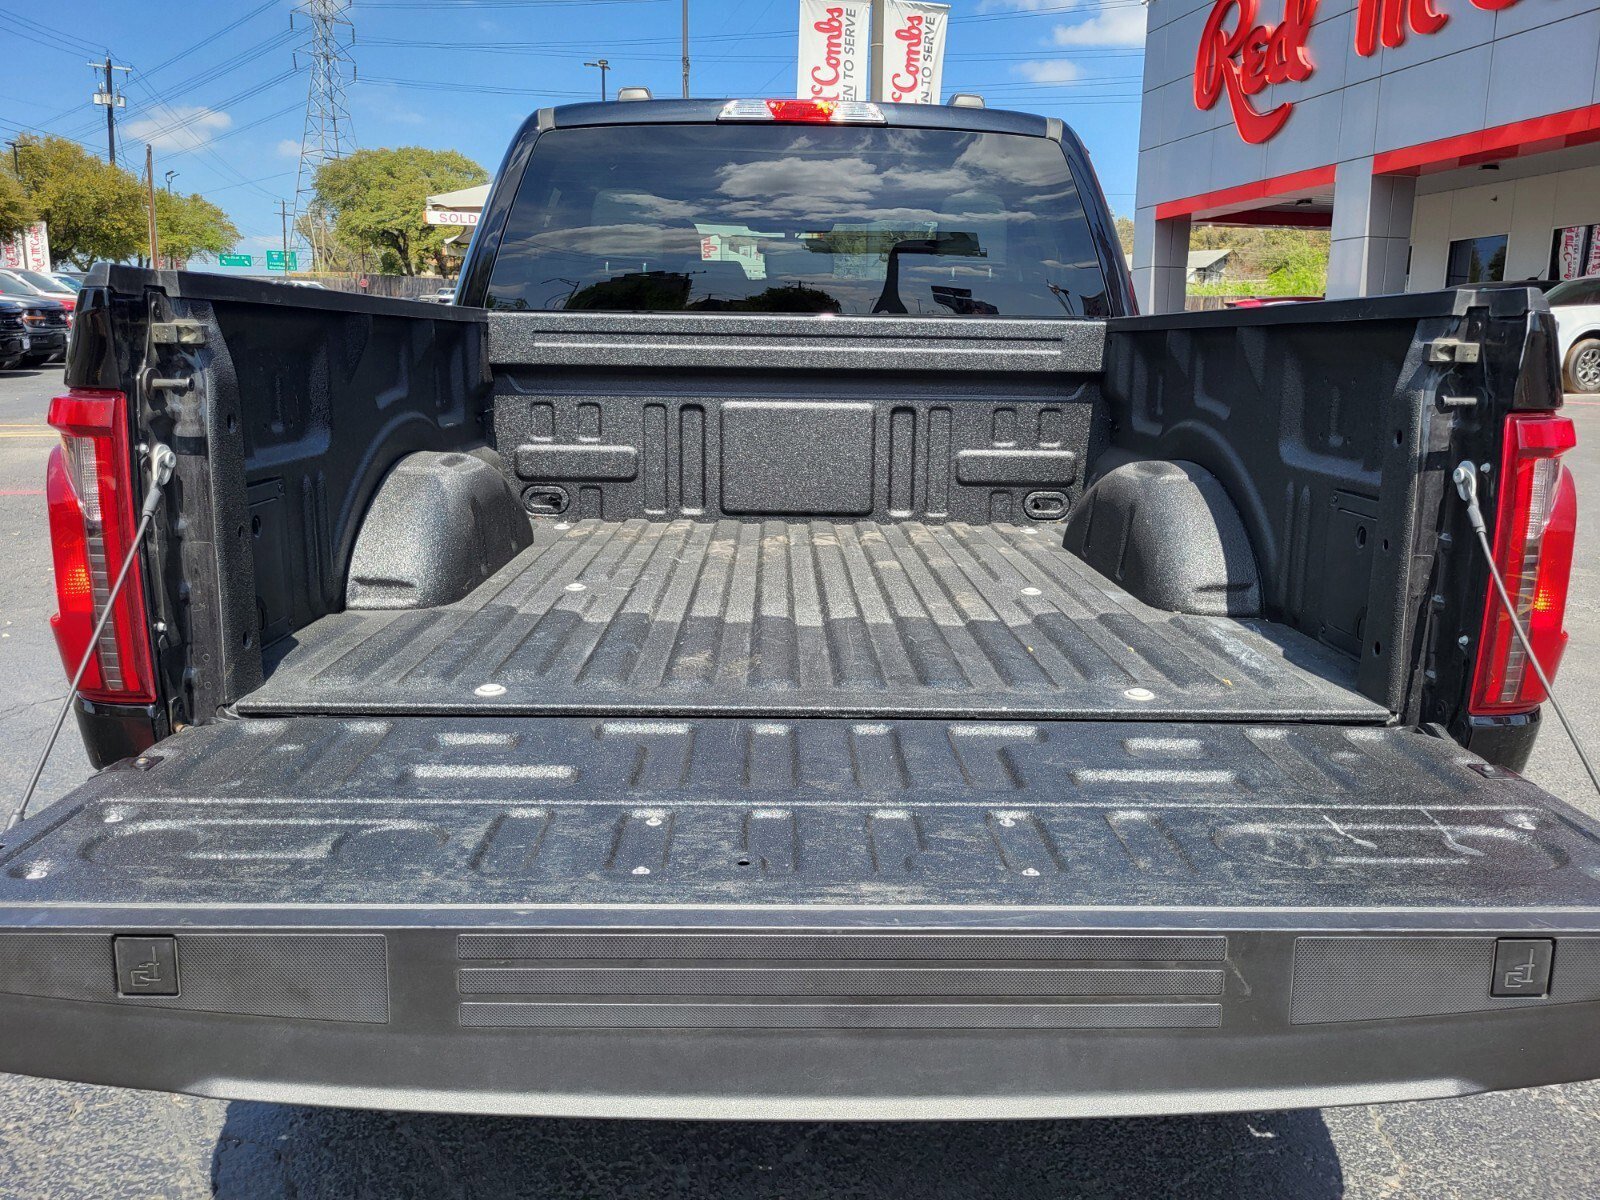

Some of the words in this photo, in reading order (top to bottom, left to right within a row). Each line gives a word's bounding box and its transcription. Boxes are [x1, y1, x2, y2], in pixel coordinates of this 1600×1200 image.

[844, 8, 857, 55] SERVE
[922, 16, 936, 62] SERVE
[843, 59, 855, 79] TO
[891, 15, 923, 103] cCombs
[921, 66, 932, 86] TO
[1195, 0, 1314, 144] Red
[440, 213, 478, 224] SOLD
